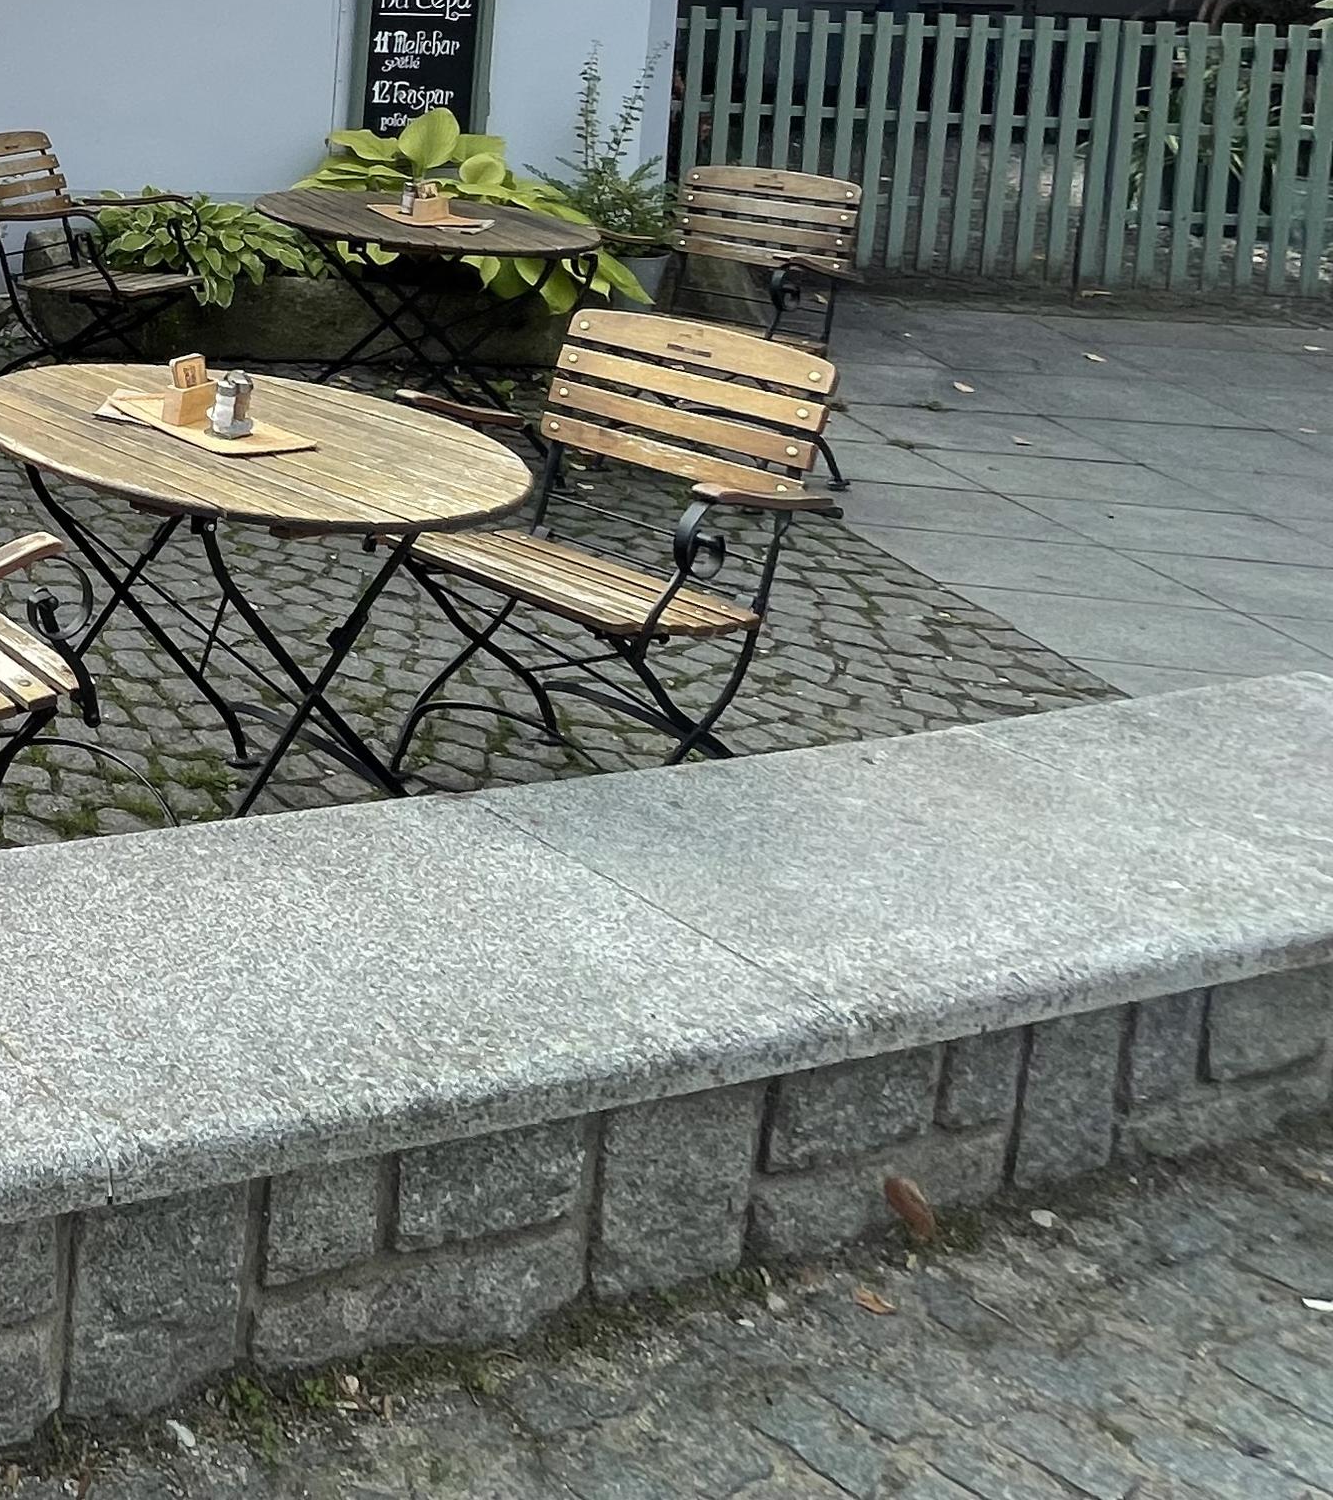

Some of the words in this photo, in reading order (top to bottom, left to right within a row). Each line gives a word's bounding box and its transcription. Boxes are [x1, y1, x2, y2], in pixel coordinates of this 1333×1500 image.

[373, 31, 393, 53] 11
[393, 30, 460, 57] Melichar
[382, 55, 421, 72] světlé
[372, 80, 393, 104] 12
[380, 112, 418, 131] polot
